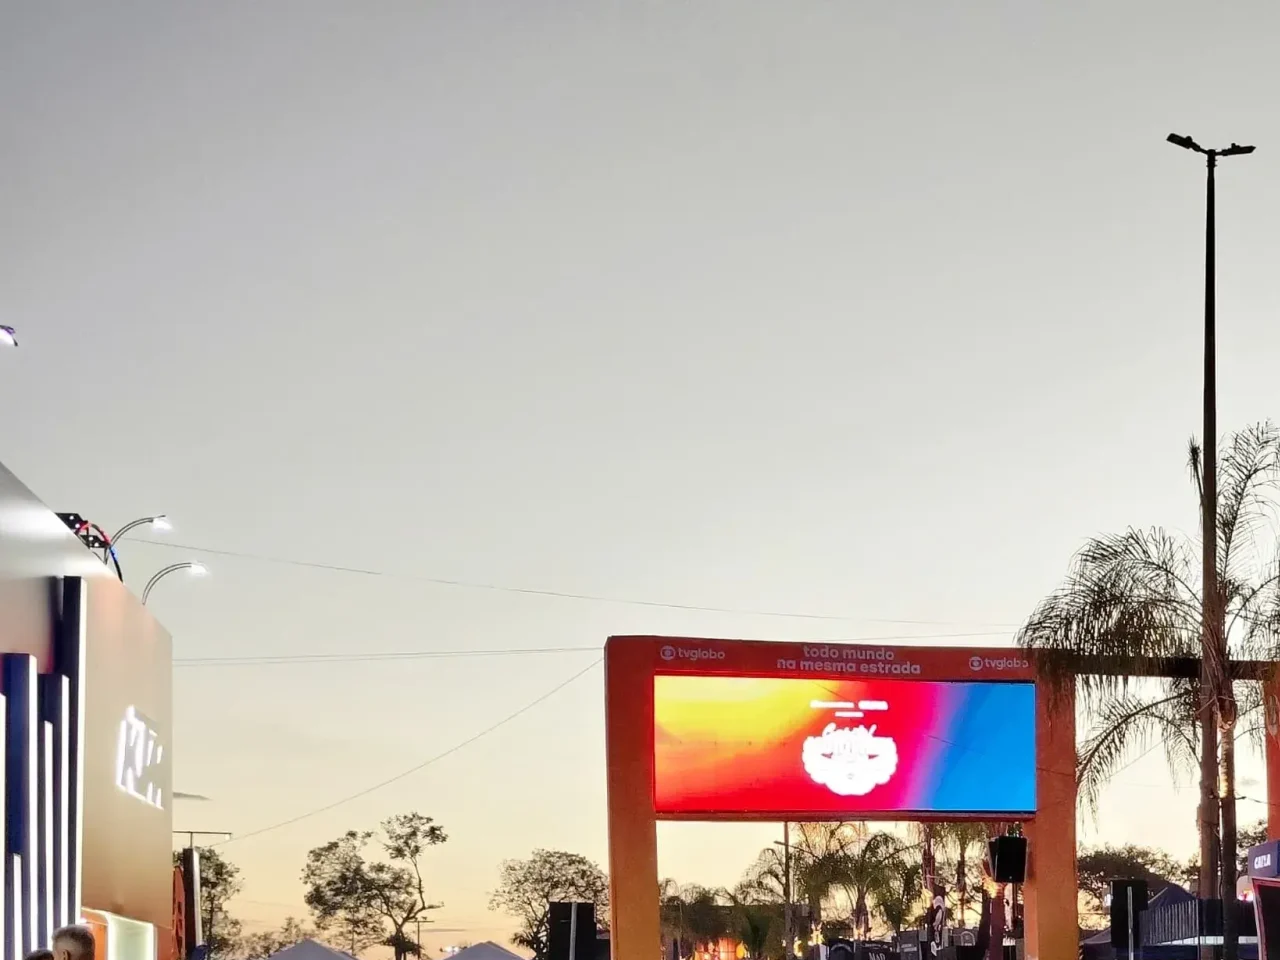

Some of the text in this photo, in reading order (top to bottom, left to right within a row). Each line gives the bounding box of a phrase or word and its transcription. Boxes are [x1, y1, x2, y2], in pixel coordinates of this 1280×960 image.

[678, 647, 726, 661] tvglobo
[802, 645, 895, 661] todo mundo
[776, 658, 921, 675] na mesma estrada
